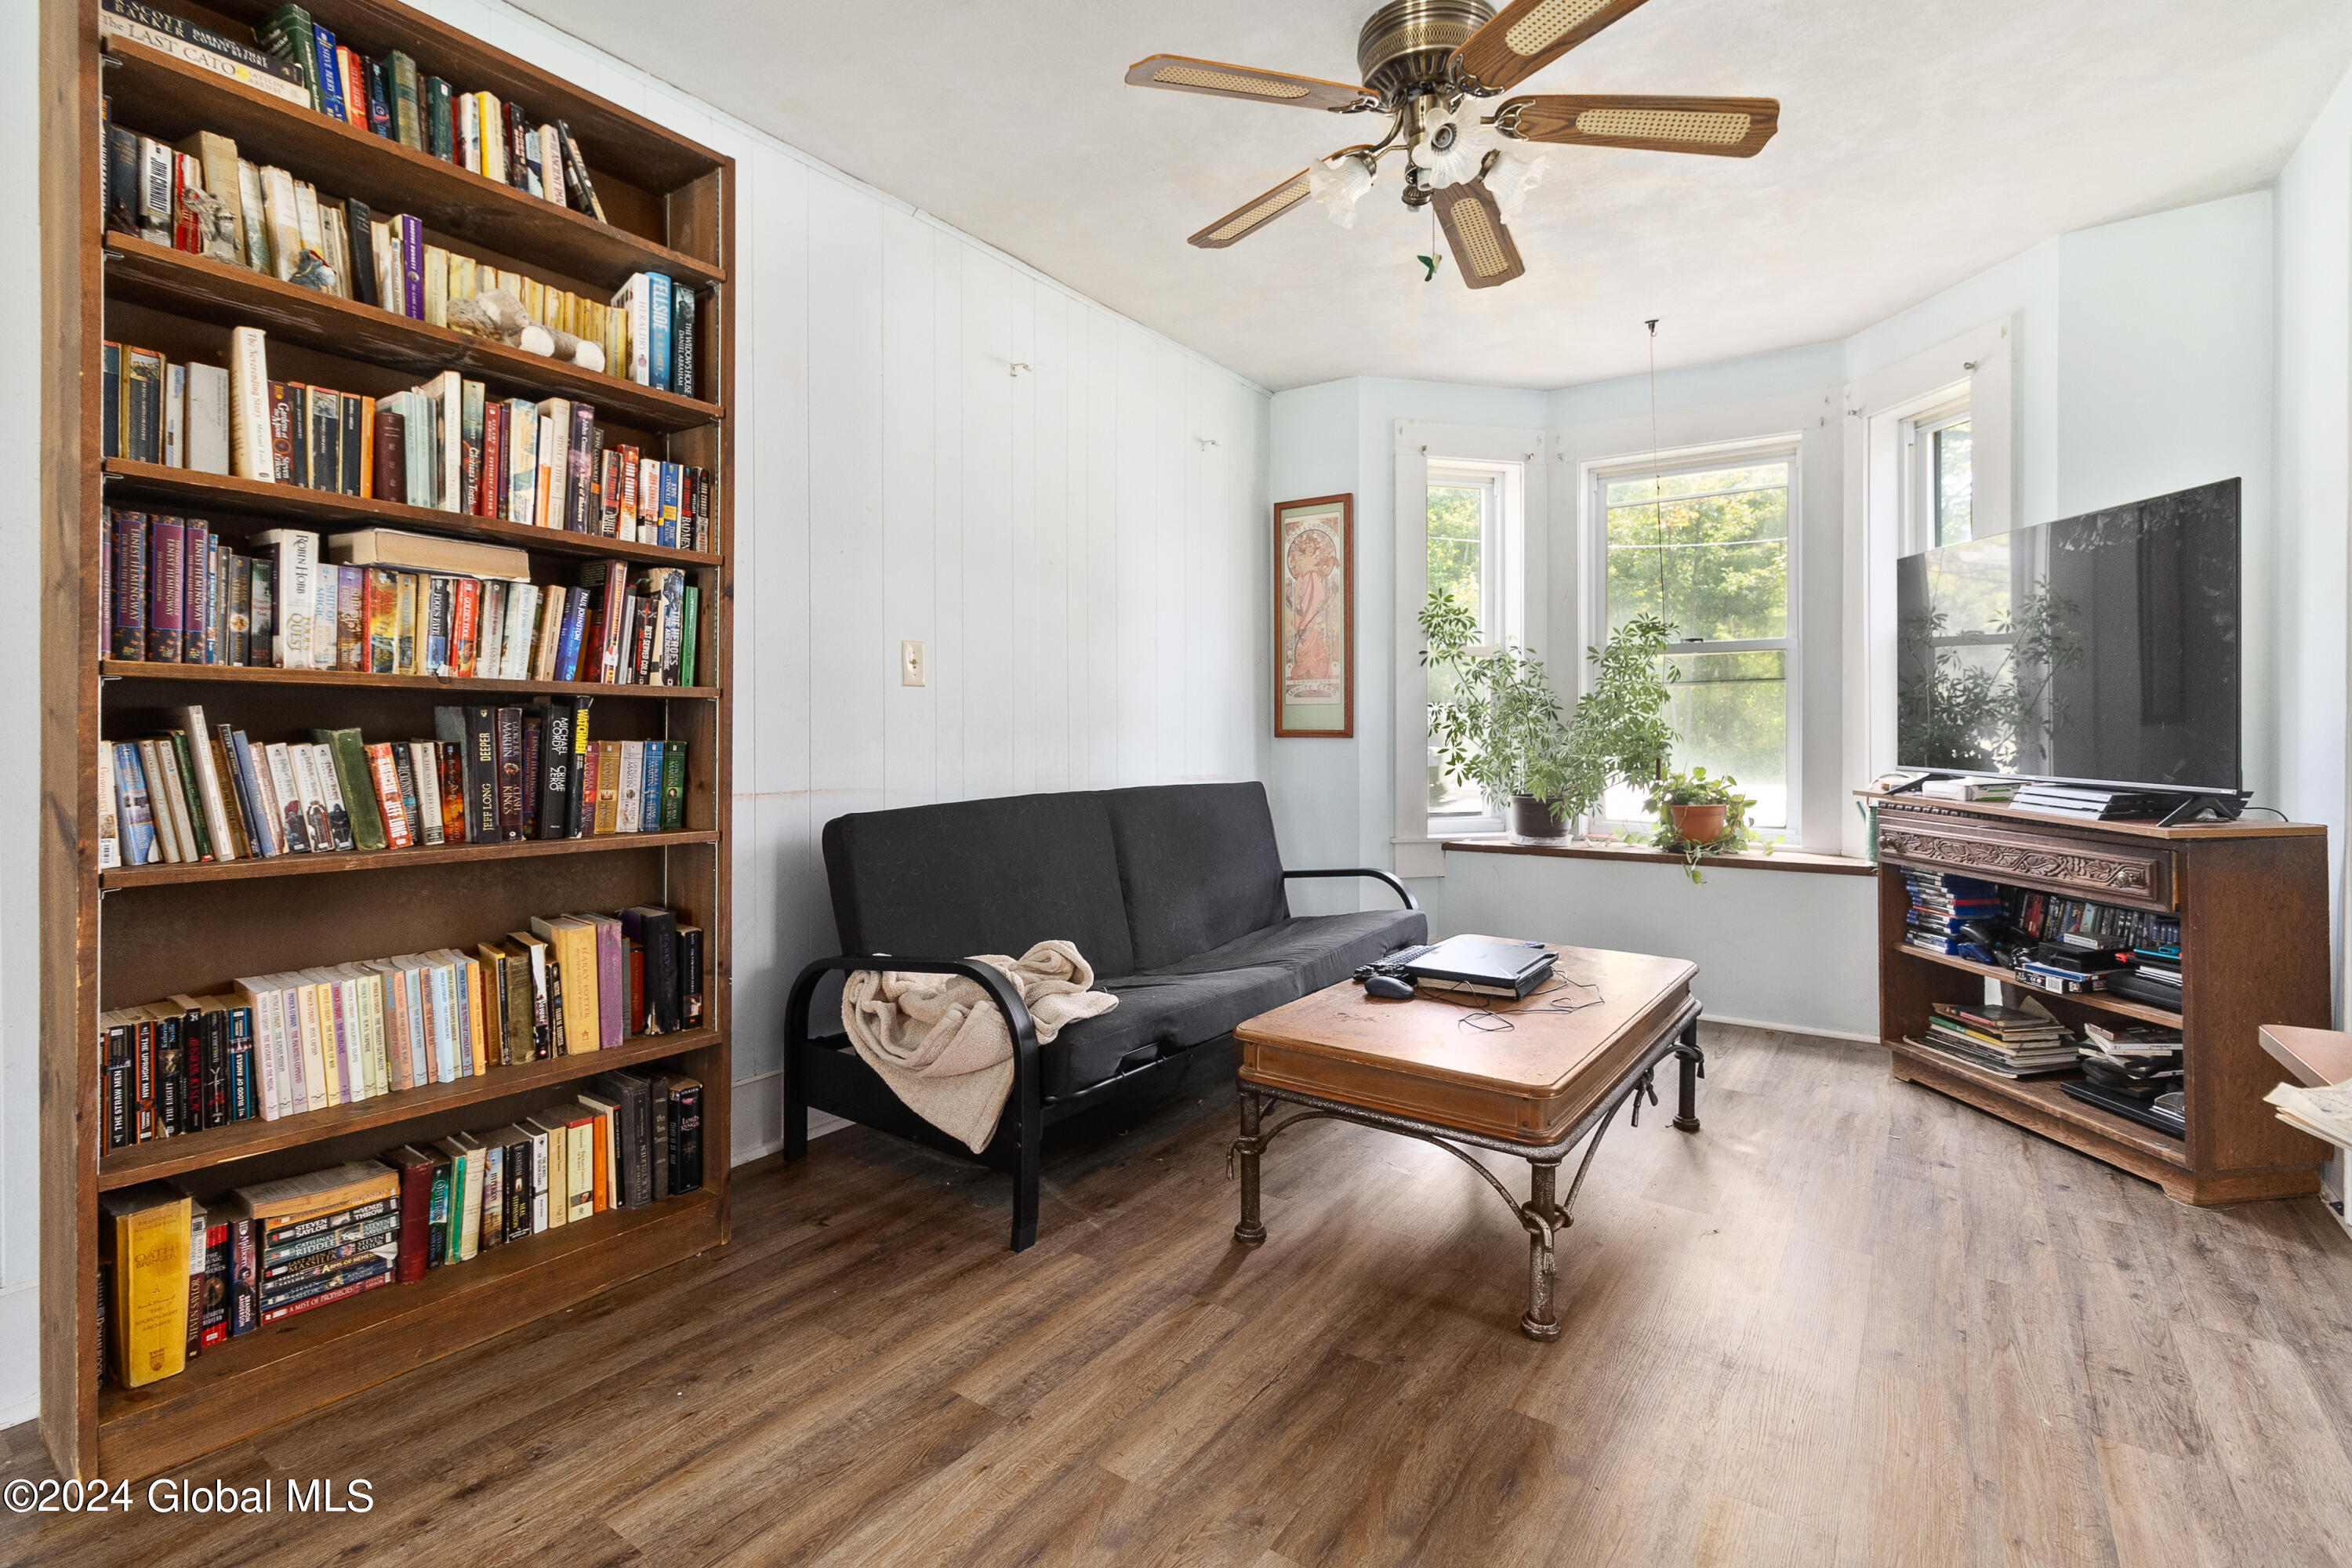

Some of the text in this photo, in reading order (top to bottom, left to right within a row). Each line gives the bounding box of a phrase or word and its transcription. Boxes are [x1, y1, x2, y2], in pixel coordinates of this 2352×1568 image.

[114, 4, 184, 38] BAKKER
[132, 1, 184, 28] SCOTT
[128, 24, 177, 53] LAST
[183, 46, 236, 75] CATO
[242, 49, 267, 62] THAT
[323, 48, 335, 93] STEVE BERRY
[150, 157, 167, 212] JOHN CONNOLLY
[551, 154, 561, 186] ANCIENT
[652, 278, 669, 332] FELLSIDE
[637, 301, 646, 351] HERALDRY
[247, 333, 261, 418] The Neverending Story
[278, 402, 289, 432] Gardens
[256, 423, 264, 448] Michael
[579, 437, 588, 465] Connolly
[282, 456, 291, 478] Steven
[468, 447, 478, 505] Gloriana's Torch
[625, 463, 636, 506] JOHN CONNOLLY
[681, 517, 691, 550] BAD MEN
[129, 528, 140, 621] ERNEST HEMINGWAY
[194, 539, 203, 622] ERNEST HEMINGWAY
[293, 535, 308, 594] ROBIN HOBB
[432, 593, 442, 636] FOOL'S FATE
[463, 597, 472, 622] GOLDEN
[574, 592, 588, 641] PAUL JOHNSTON
[286, 613, 301, 652] QUEST
[670, 611, 681, 666] THE HEROES
[640, 626, 653, 674] BEST SERVED COLD
[1287, 684, 1338, 697] WHITE STAR
[479, 733, 492, 761] DEEPER
[503, 721, 514, 757] MARTIN
[551, 720, 560, 752] CORDY
[558, 717, 569, 756] MICHAEL
[575, 709, 589, 755] WATCHMEN
[397, 765, 412, 798] RECKONING
[529, 761, 538, 807] HEMINGWAY
[549, 767, 559, 791] ZERO
[557, 765, 566, 792] CRIME
[380, 764, 407, 839] DESCENT JEFF LONG
[482, 783, 495, 831] JEFF LONG
[503, 786, 514, 815] KINGS
[535, 999, 546, 1023] Pavane
[189, 1036, 201, 1111] ACTS WORSHIP
[237, 1077, 243, 1086] OF
[114, 1070, 123, 1131] THE STRAW MEN
[165, 1106, 174, 1122] THE
[354, 1207, 383, 1220] THROW
[360, 1202, 383, 1213] VENUS
[432, 1179, 446, 1221] QUIETUS
[295, 1218, 328, 1231] STEVEN
[296, 1225, 328, 1238] SAYLOR
[365, 1218, 390, 1229] STEVEN
[135, 1244, 175, 1263] OATH
[239, 1236, 249, 1268] Mistborn
[295, 1233, 335, 1249] CATILINA'S
[296, 1240, 336, 1256] RIDDLE
[357, 1234, 384, 1247] STEVEN
[357, 1240, 384, 1252] SAYLOR
[289, 1254, 337, 1273] MASSILIA
[189, 1278, 201, 1341] STEVEN SAYLOR
[295, 1286, 354, 1311] MIST OF PROPHECIES
